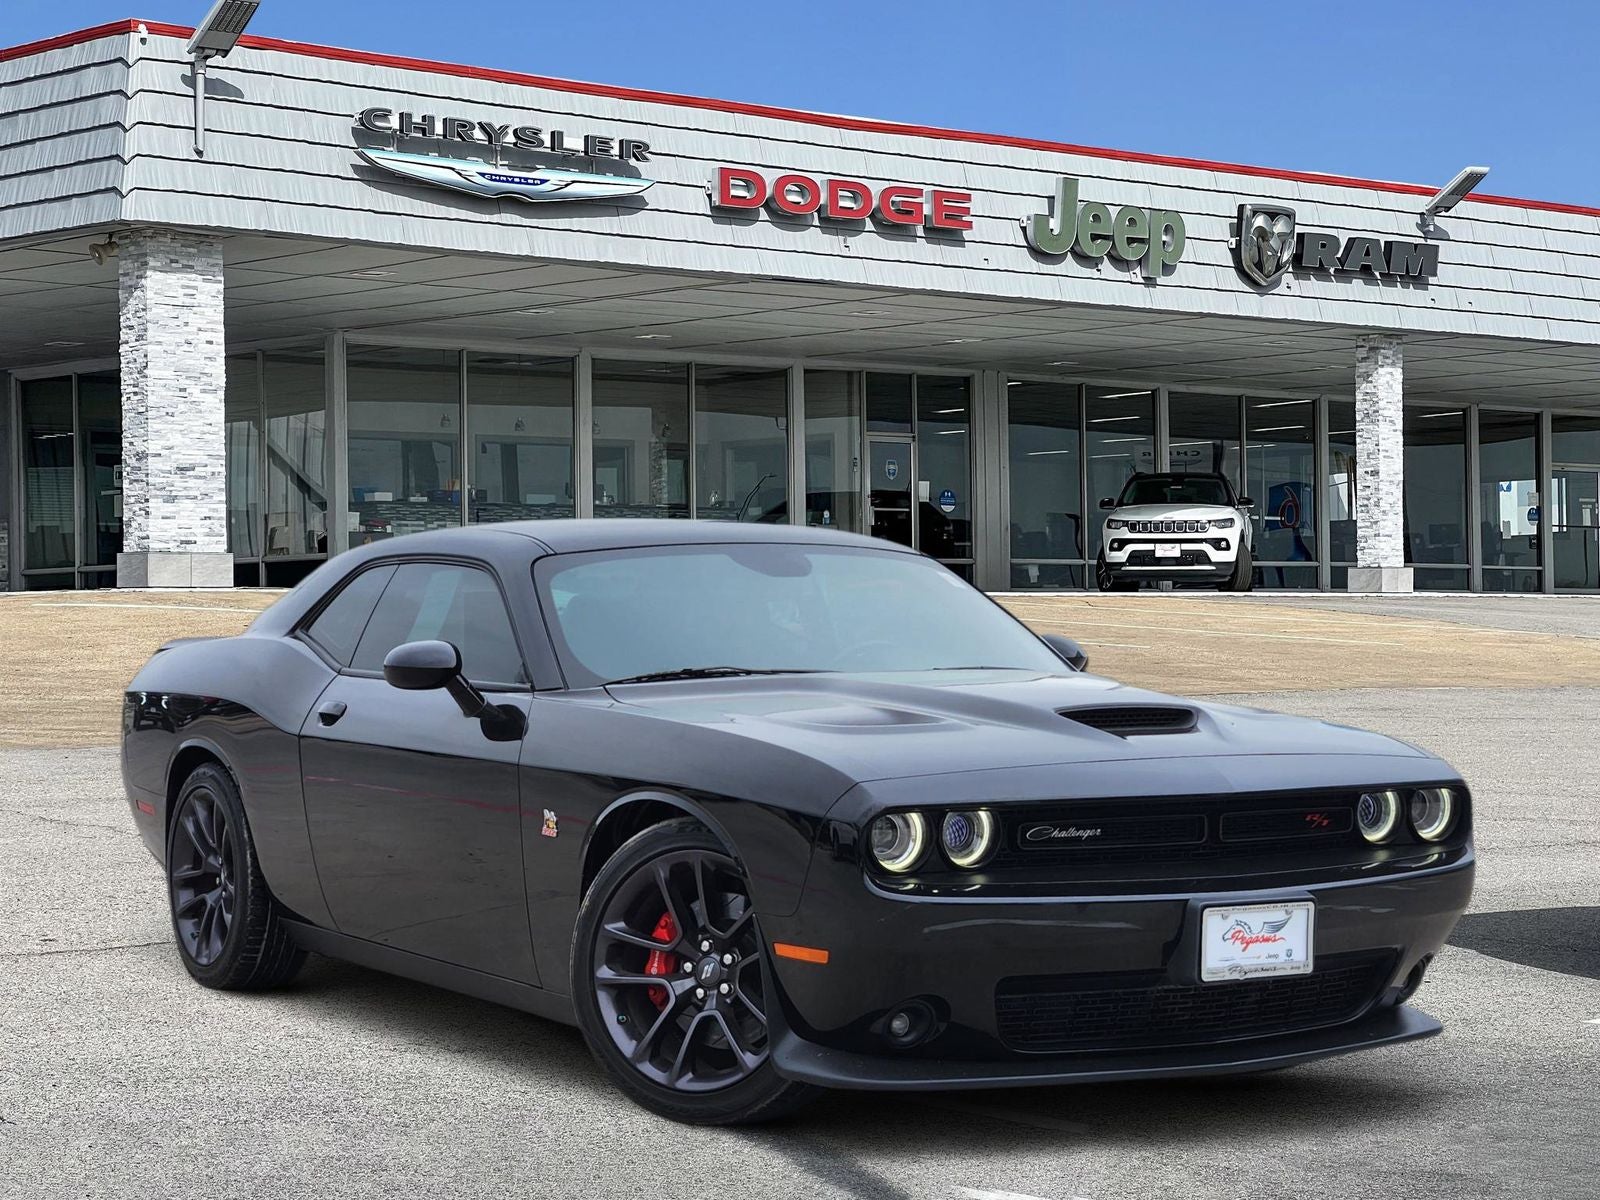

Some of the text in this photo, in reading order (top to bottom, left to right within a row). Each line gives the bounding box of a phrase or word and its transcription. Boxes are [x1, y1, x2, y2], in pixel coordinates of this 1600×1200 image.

[357, 106, 651, 162] CHRYSLER
[484, 174, 541, 185] CHRYSLER
[712, 166, 973, 231] DODGE
[1026, 177, 1186, 278] Jeep
[1296, 232, 1440, 278] RAM
[1026, 826, 1102, 840] Challenger
[1231, 930, 1286, 952] Pegasus
